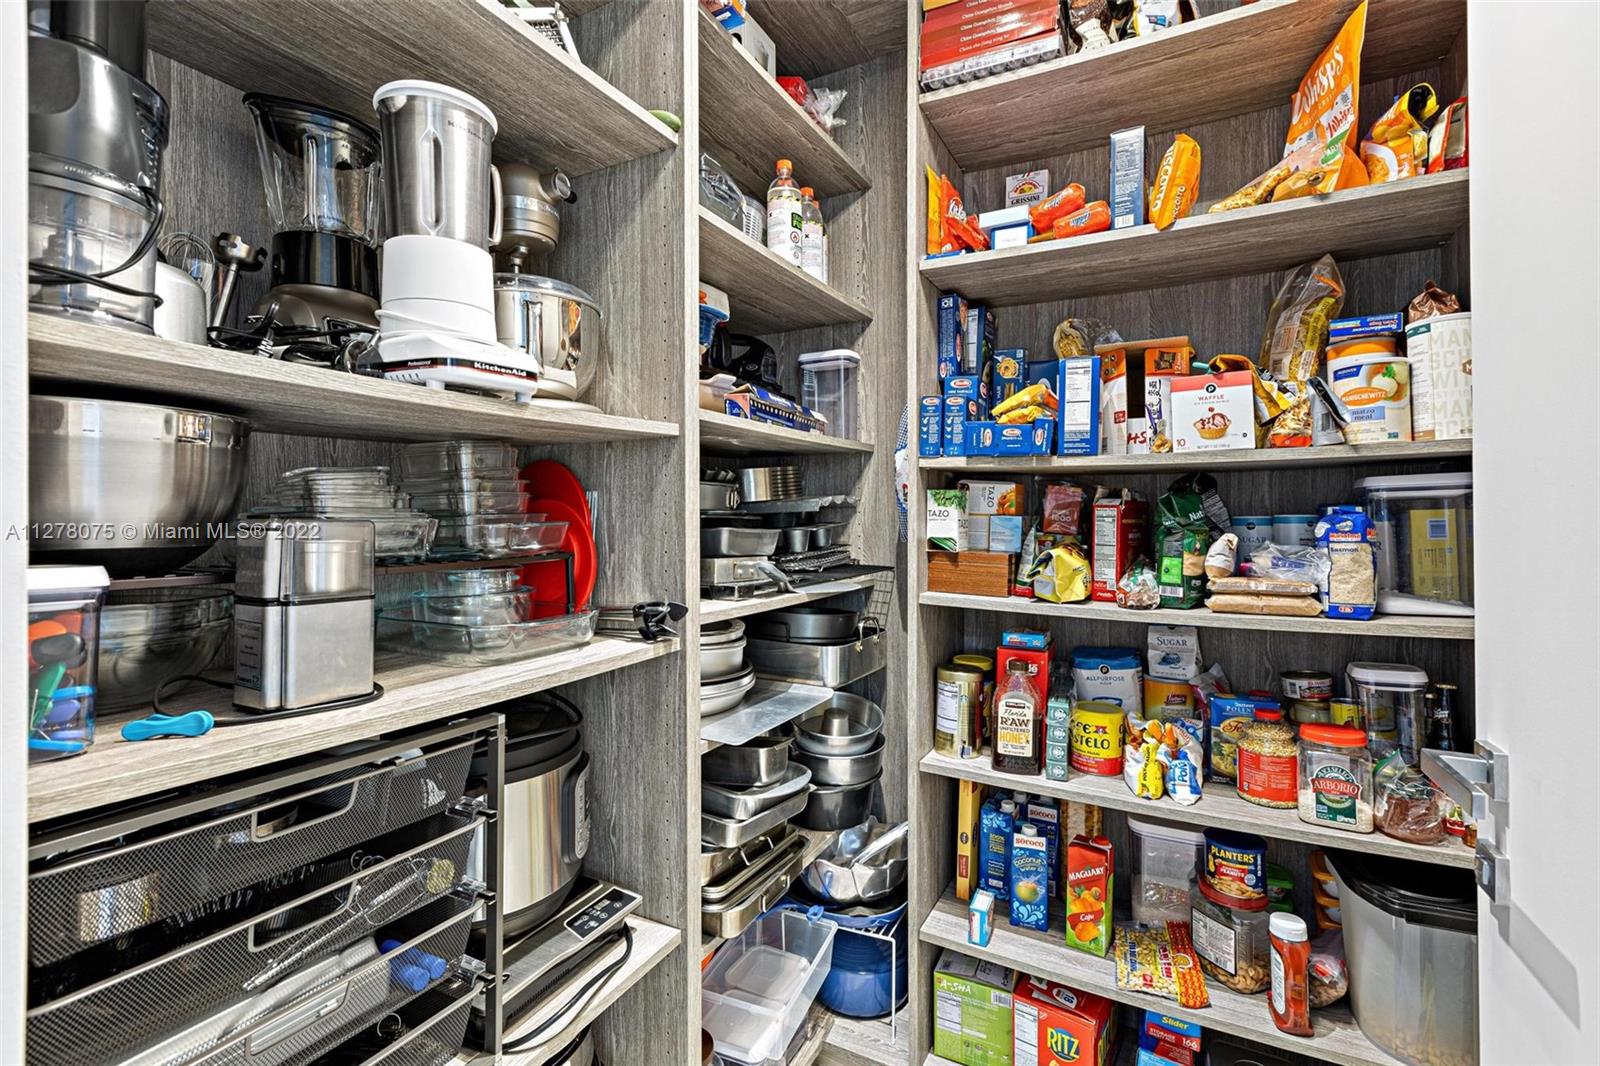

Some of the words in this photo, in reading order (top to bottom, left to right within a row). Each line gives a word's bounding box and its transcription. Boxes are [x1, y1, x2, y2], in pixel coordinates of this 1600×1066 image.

[474, 362, 527, 377] KitchenAid
[987, 486, 995, 508] TAZO
[928, 509, 950, 518] TAZO
[1000, 716, 1030, 728] RAW
[999, 732, 1029, 745] HONEY
[1313, 780, 1358, 795] ARBORIO
[1211, 844, 1254, 864] PLANTERS
[1068, 866, 1104, 880] MAGUARY
[940, 979, 971, 993] A-SHA
[1161, 1016, 1189, 1030] Slider
[1047, 1027, 1080, 1059] RITZ
